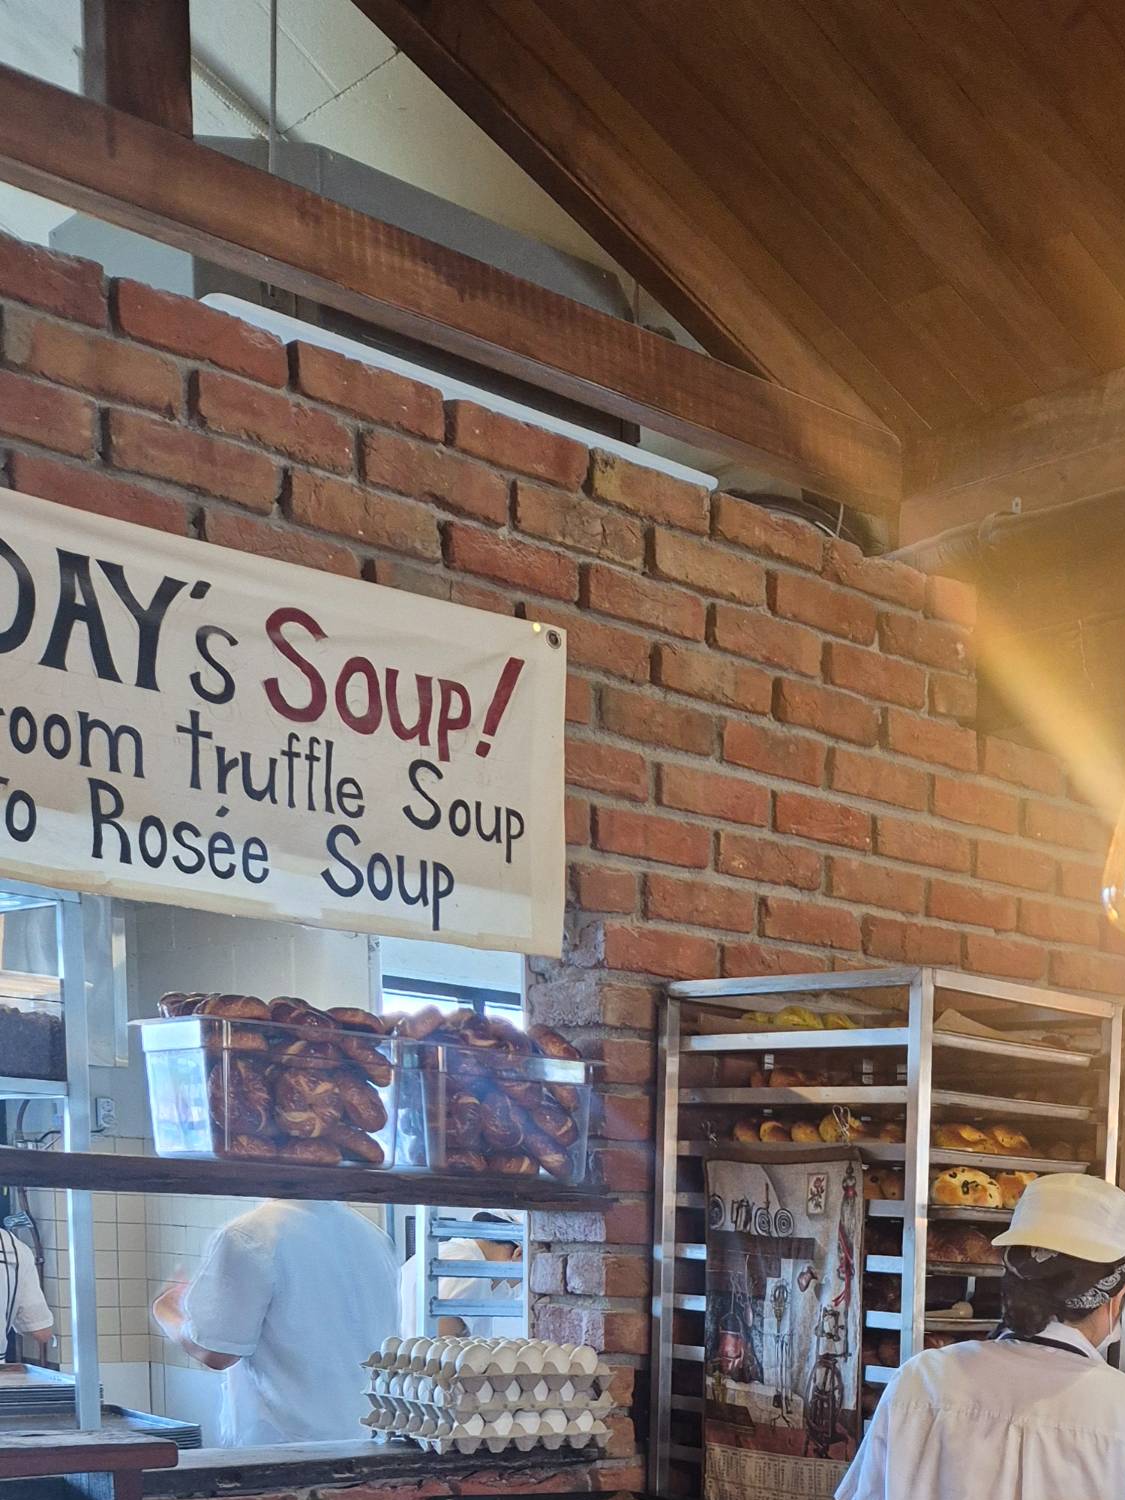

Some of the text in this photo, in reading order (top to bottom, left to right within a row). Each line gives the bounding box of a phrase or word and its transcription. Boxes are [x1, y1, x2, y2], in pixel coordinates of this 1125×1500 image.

[263, 606, 525, 762] Soup!
[0, 706, 525, 863] oom truffle Soup
[88, 777, 270, 884] Rosée
[321, 823, 455, 931] Soup
